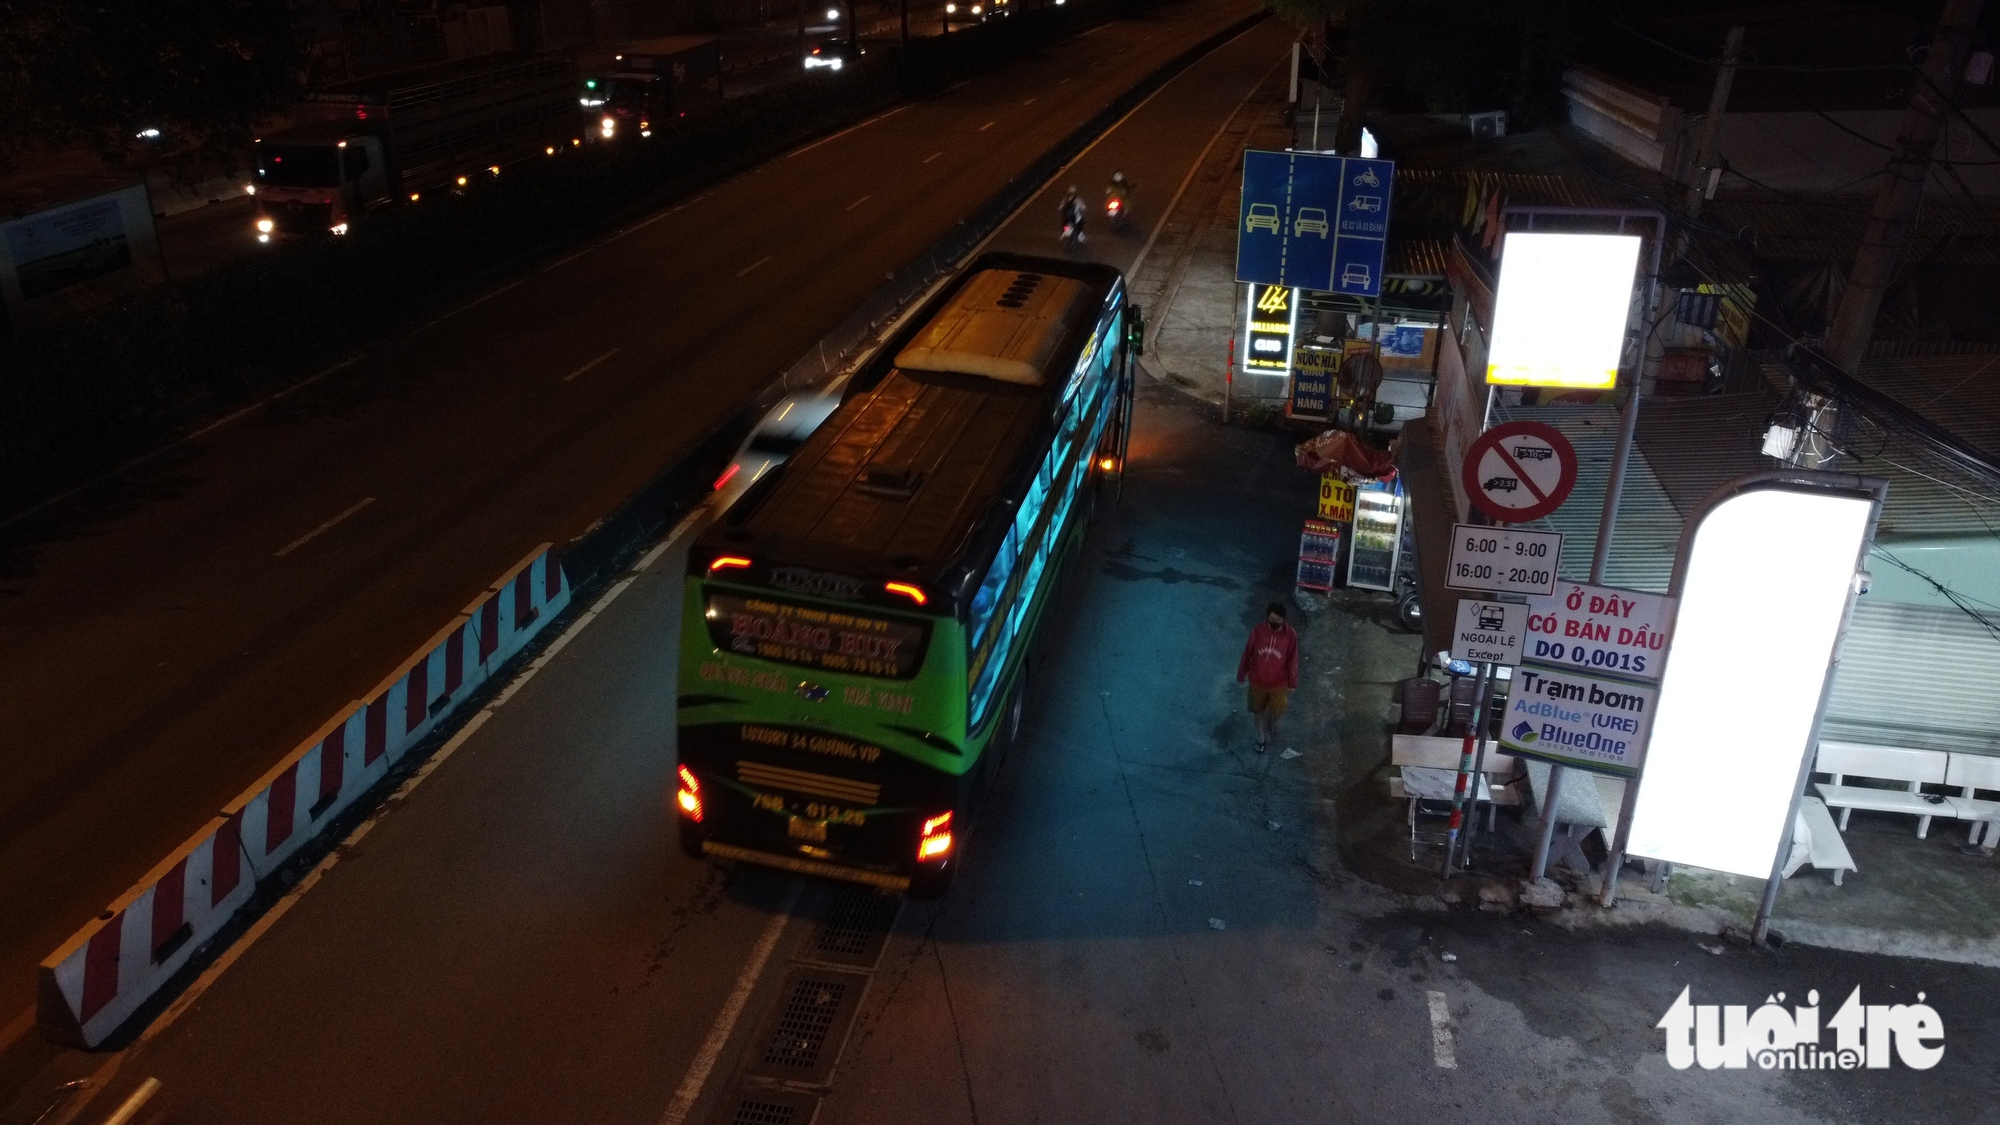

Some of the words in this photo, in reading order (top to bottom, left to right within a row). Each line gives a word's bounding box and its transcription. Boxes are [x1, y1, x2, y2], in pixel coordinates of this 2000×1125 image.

[1298, 381, 1326, 394] NHẬN
[1297, 397, 1324, 410] HÀNG
[1321, 481, 1332, 499] Ô
[1335, 485, 1353, 504] TÔ
[1466, 538, 1497, 553] 6:00
[1515, 541, 1547, 557] 9:00
[1456, 563, 1492, 579] 16:00
[1508, 568, 1549, 585] 20:00
[1566, 586, 1585, 611] Ở
[1589, 594, 1636, 619] ĐÂY
[1460, 633, 1497, 646] NGOẠI
[1500, 635, 1516, 649] LỆ
[1528, 612, 1557, 634] CÓ
[1564, 618, 1611, 642] BÁN
[1617, 623, 1664, 650] DẦU
[1467, 648, 1504, 661] Except
[1535, 640, 1565, 659] DO
[1571, 646, 1646, 672] 0,001S
[1521, 671, 1585, 702] Trạm
[1588, 684, 1645, 712] bơm
[1591, 713, 1639, 735] (URE)
[1540, 723, 1626, 755] BlueOne
[1538, 741, 1573, 753] GREEN
[1579, 748, 1623, 762] MOTION
